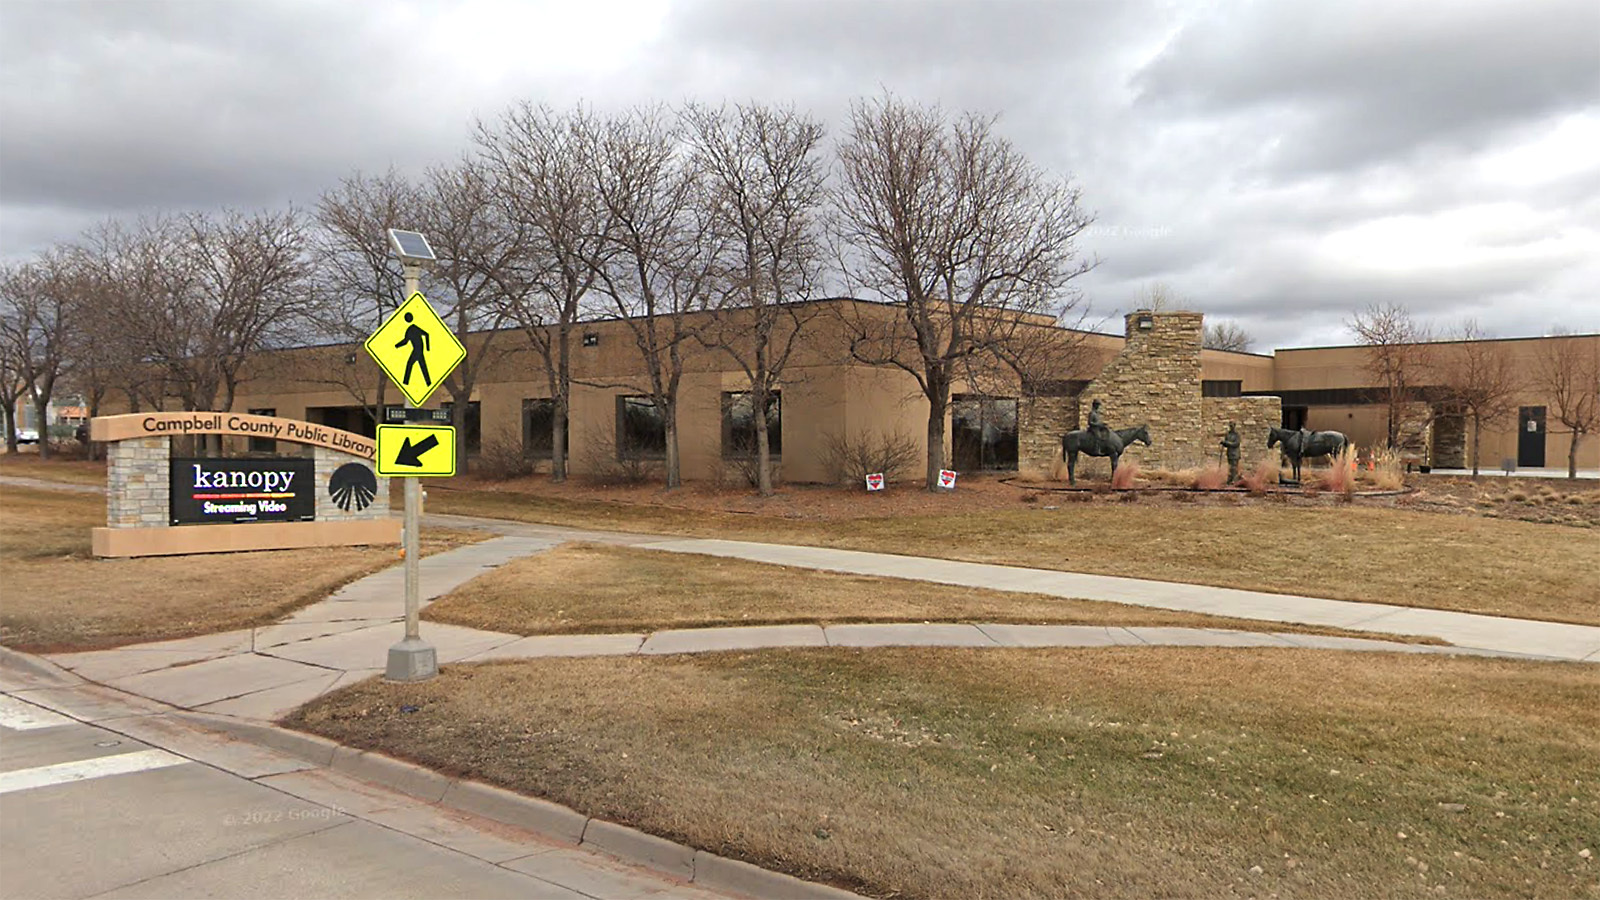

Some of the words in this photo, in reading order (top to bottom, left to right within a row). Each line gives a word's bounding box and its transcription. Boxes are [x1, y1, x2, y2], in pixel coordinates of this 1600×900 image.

[143, 415, 222, 435] Campbell
[228, 417, 282, 438] County
[287, 424, 328, 444] Public
[332, 433, 377, 458] Library
[193, 464, 295, 492] kanopy
[203, 501, 257, 515] Streaming
[258, 500, 287, 513] Video
